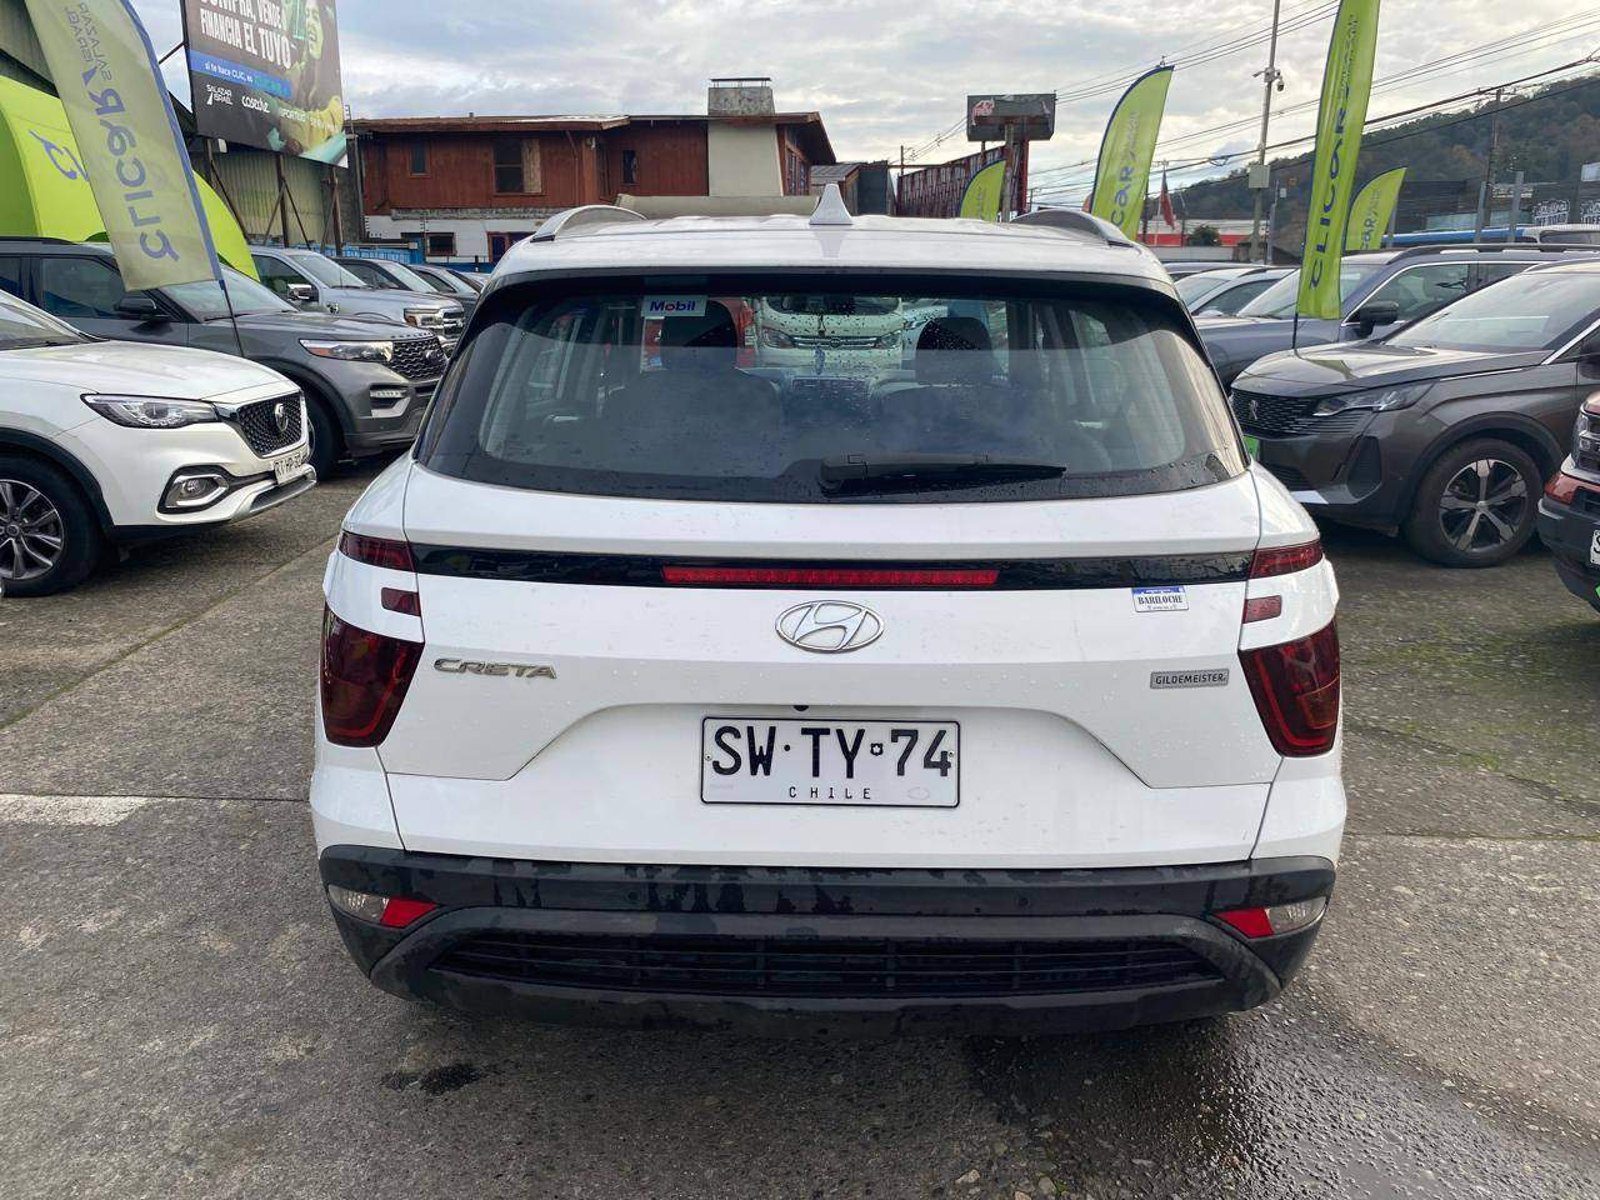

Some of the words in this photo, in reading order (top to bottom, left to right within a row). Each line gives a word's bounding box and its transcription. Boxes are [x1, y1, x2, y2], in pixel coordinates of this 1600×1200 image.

[200, 8, 243, 50] FINANCIA
[243, 22, 258, 56] EL
[258, 27, 291, 70] TUYO
[650, 300, 696, 312] Mobil
[433, 658, 557, 679] CRETA
[1155, 672, 1225, 686] GILDEMEISTER
[789, 786, 871, 800] CHILE
